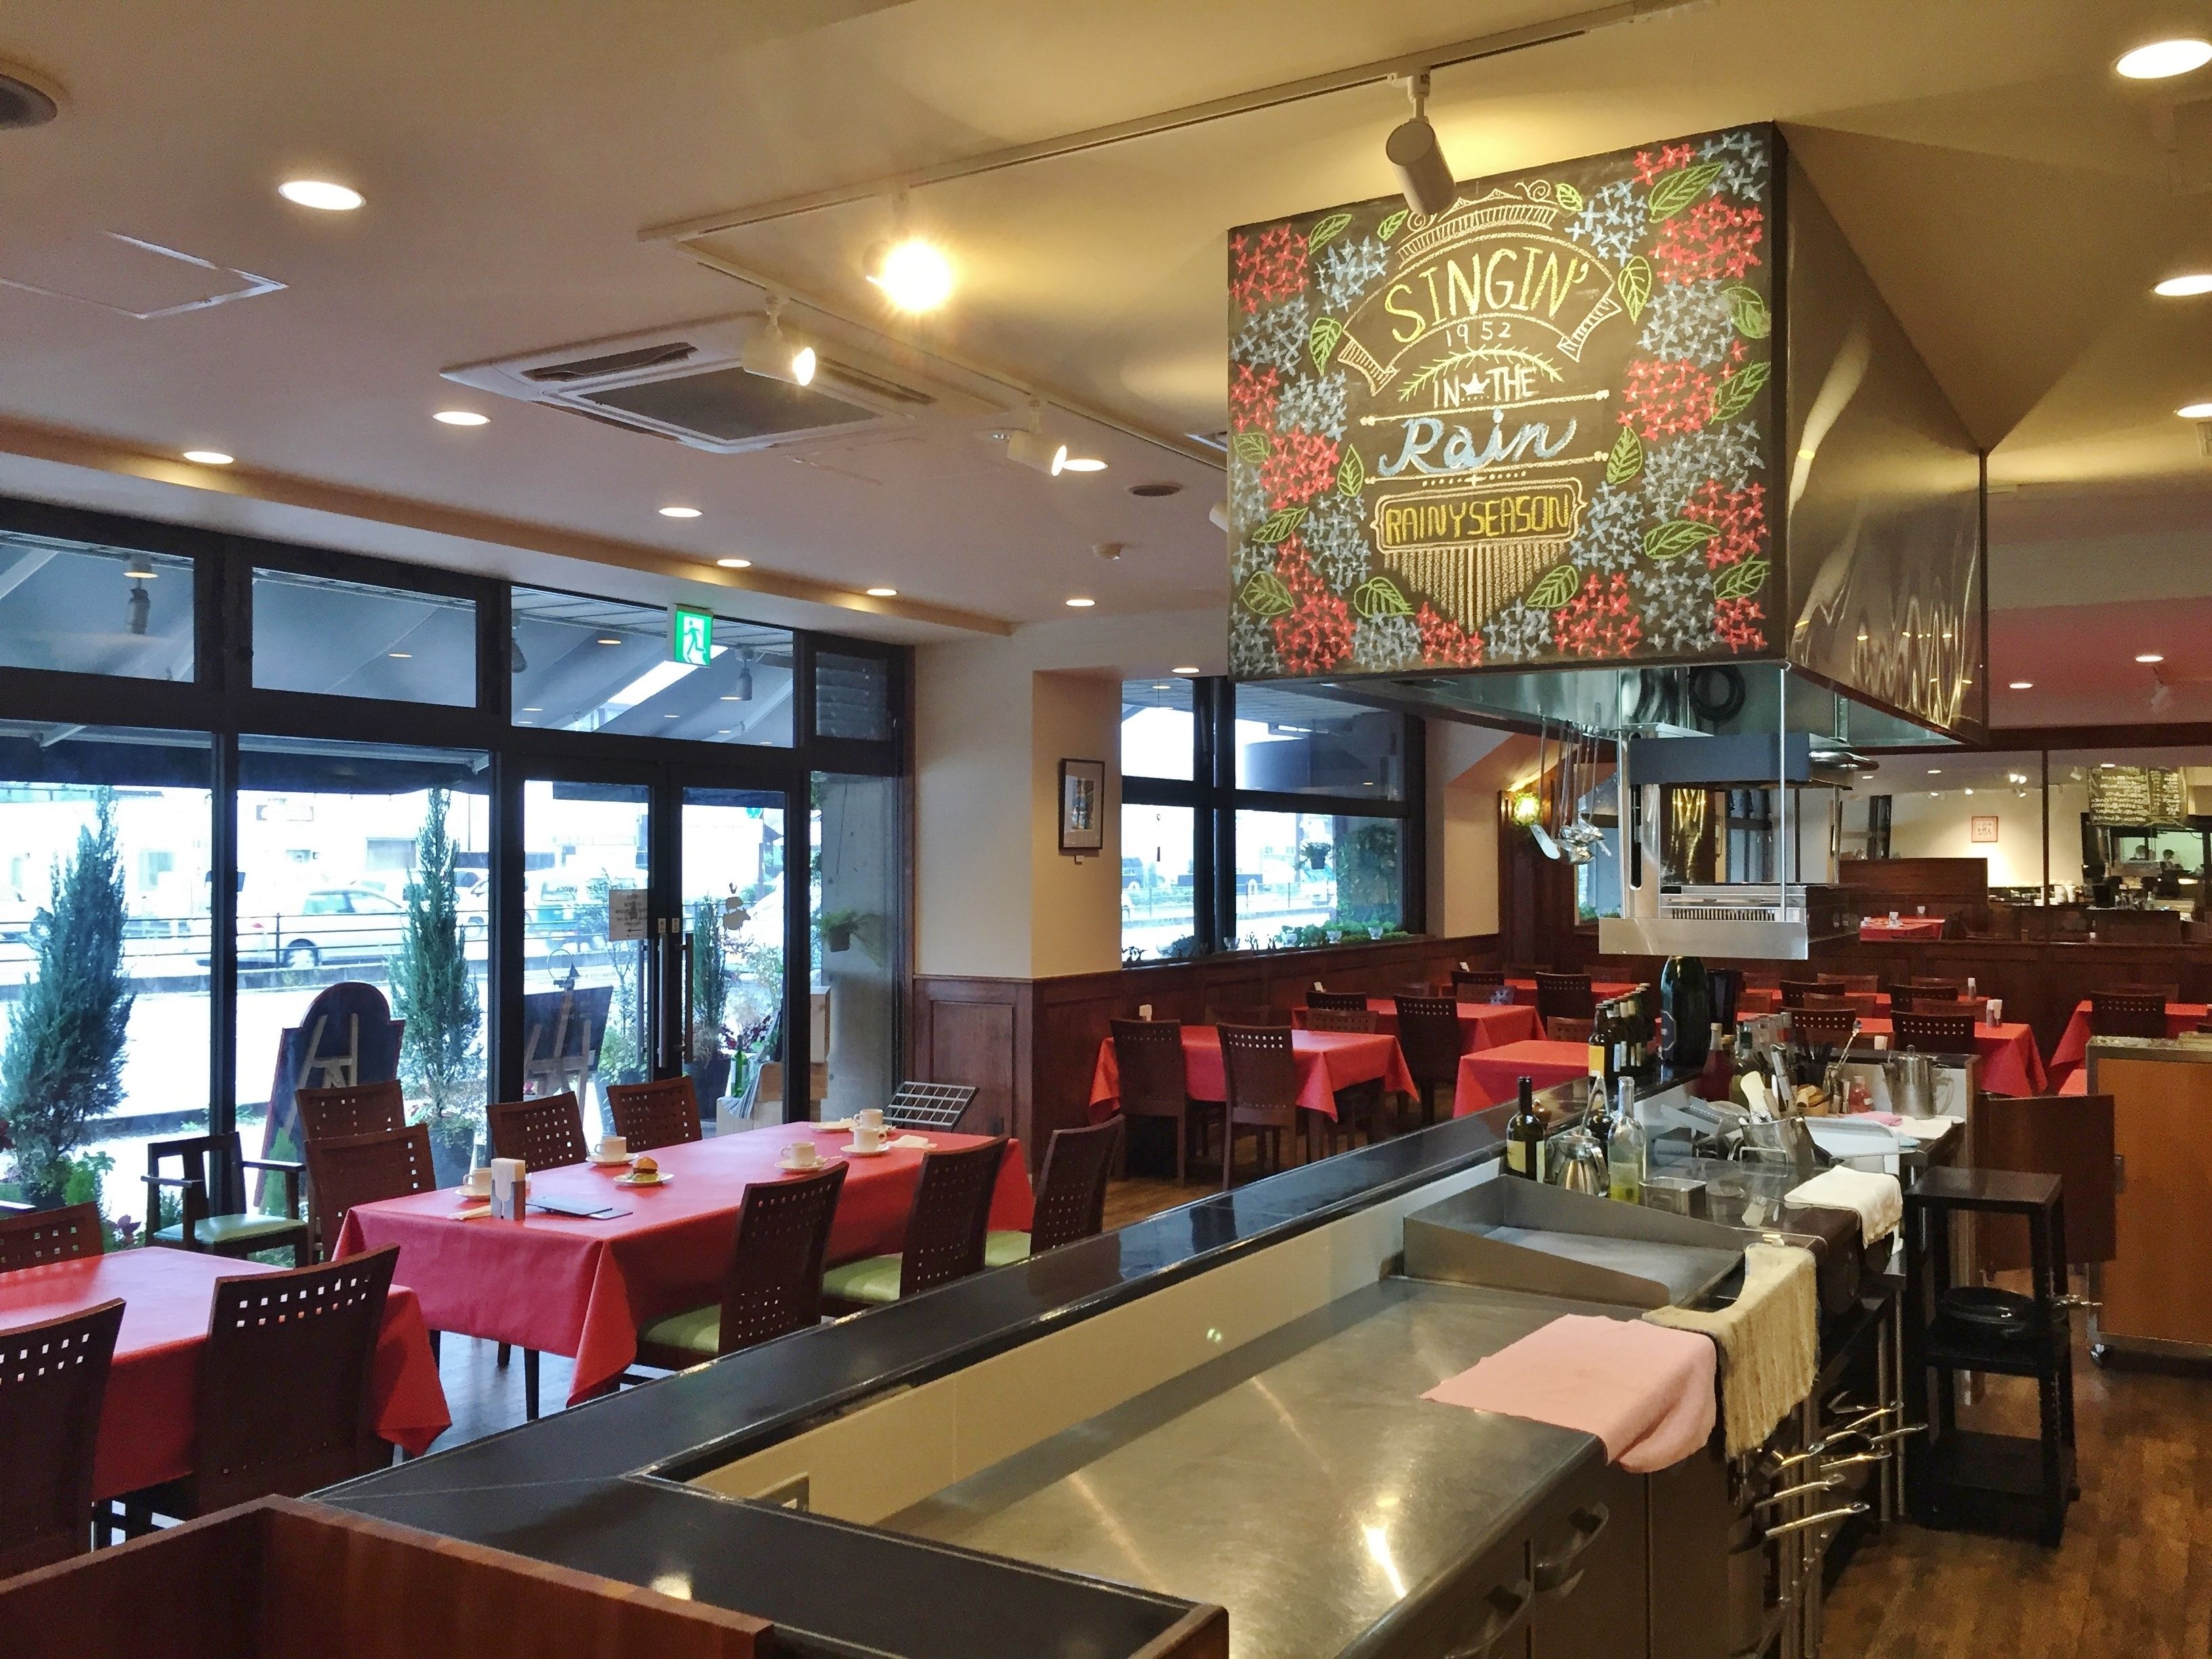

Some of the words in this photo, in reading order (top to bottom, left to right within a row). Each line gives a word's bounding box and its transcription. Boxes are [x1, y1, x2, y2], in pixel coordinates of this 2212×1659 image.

[1446, 321, 1511, 348] 1952
[1434, 376, 1459, 408] IN
[1486, 364, 1539, 401] THE
[1378, 409, 1577, 476] Rain
